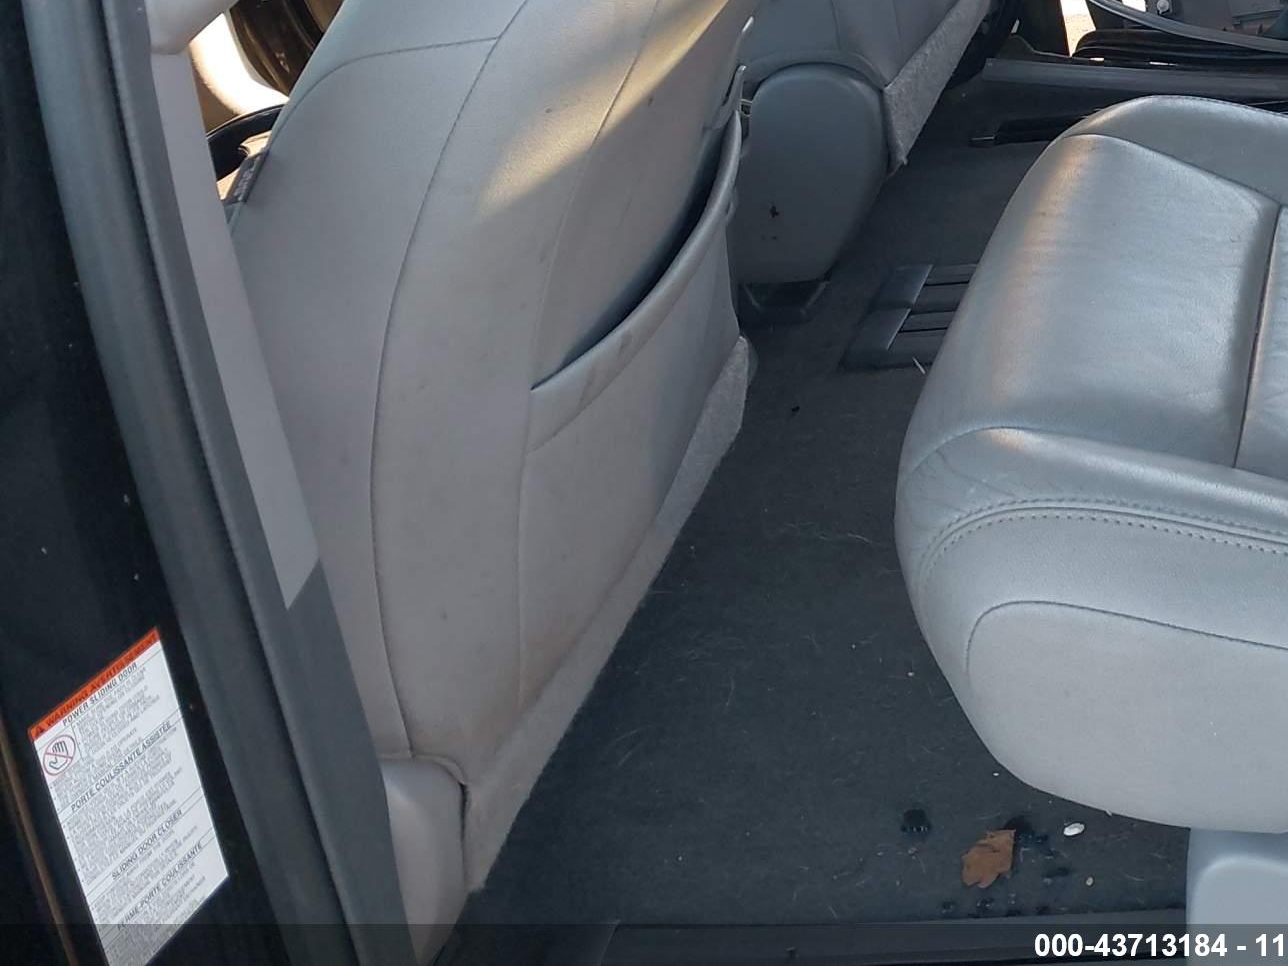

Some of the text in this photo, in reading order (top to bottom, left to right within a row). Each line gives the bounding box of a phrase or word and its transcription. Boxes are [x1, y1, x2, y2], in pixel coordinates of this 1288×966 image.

[62, 662, 138, 726] POWER SLIDING DOOR
[70, 788, 95, 812] PORTE
[95, 750, 142, 792] COULISSANTE
[111, 809, 183, 879] SLIDING DOOR CLOSER
[161, 840, 202, 887] COULISSANTE
